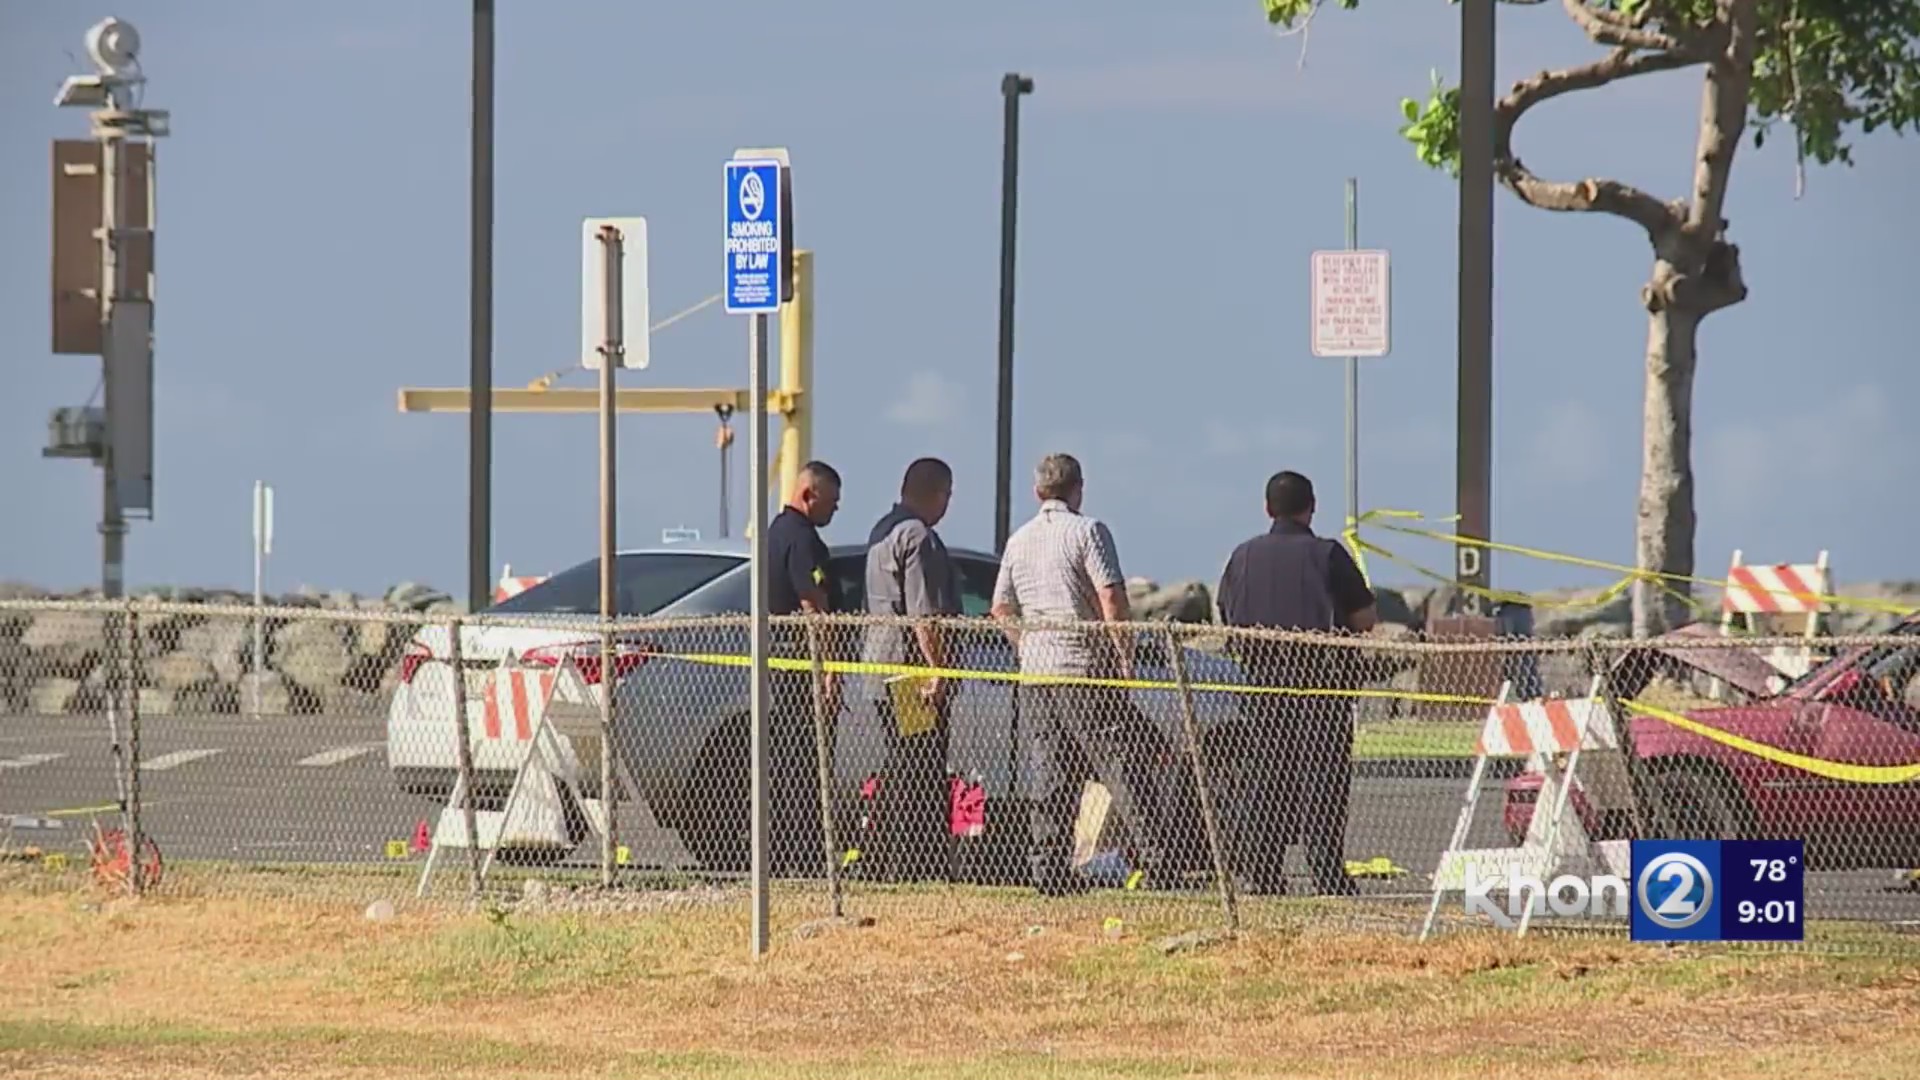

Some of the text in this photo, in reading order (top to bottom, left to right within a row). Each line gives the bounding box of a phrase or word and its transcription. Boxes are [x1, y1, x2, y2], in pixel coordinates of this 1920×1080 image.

[731, 221, 773, 237] SMOKING
[728, 238, 777, 253] PROHIBITED
[735, 254, 769, 269] BY LAW
[1325, 296, 1356, 304] PARKING
[1333, 316, 1365, 325] PARKING
[1460, 547, 1480, 576] D
[1463, 591, 1480, 616] 3
